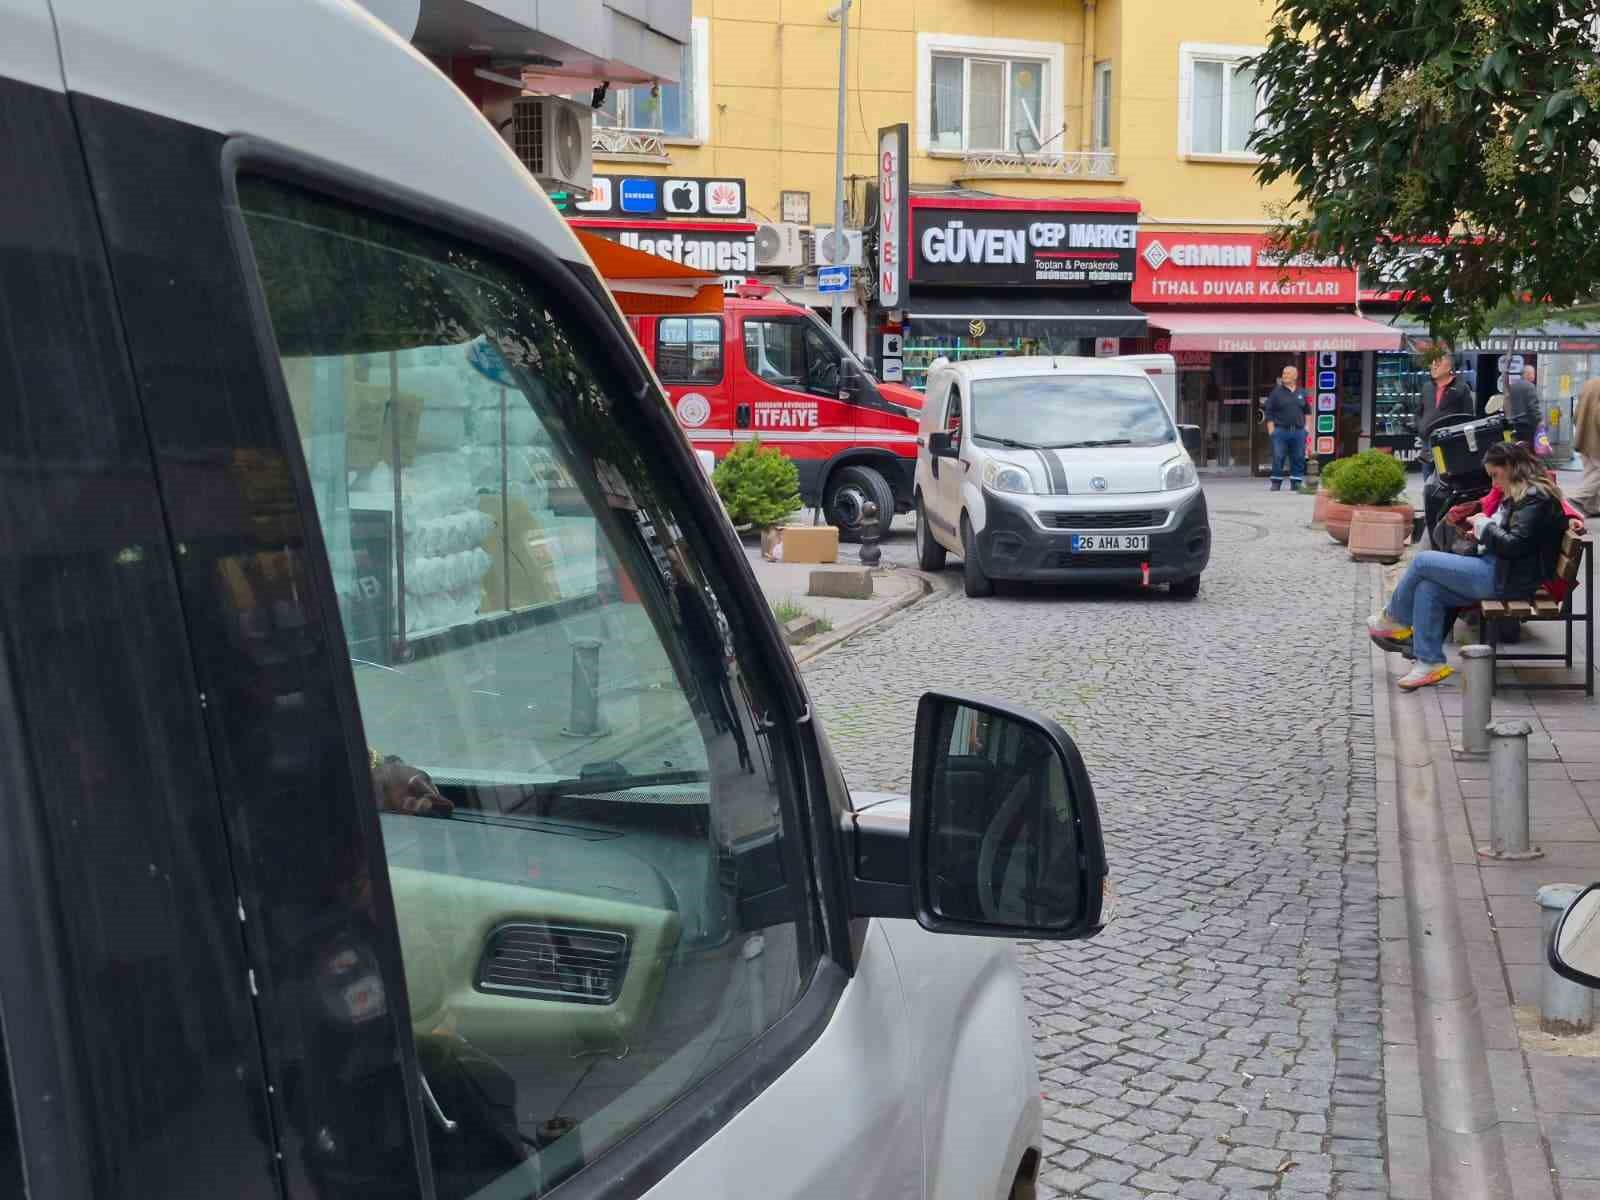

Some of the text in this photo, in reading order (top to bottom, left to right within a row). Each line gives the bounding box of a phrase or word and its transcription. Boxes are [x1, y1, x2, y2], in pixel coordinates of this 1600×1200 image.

[881, 151, 895, 295] GÜVEN
[921, 220, 1026, 264] GÜVEN
[1029, 222, 1138, 249] CEP MARKET
[1074, 261, 1119, 271] Perakende
[1170, 244, 1252, 267] ERMAN
[1152, 277, 1198, 296] İTHAL
[1203, 280, 1254, 295] DUVAR
[1080, 536, 1146, 549] 26 AHA 301
